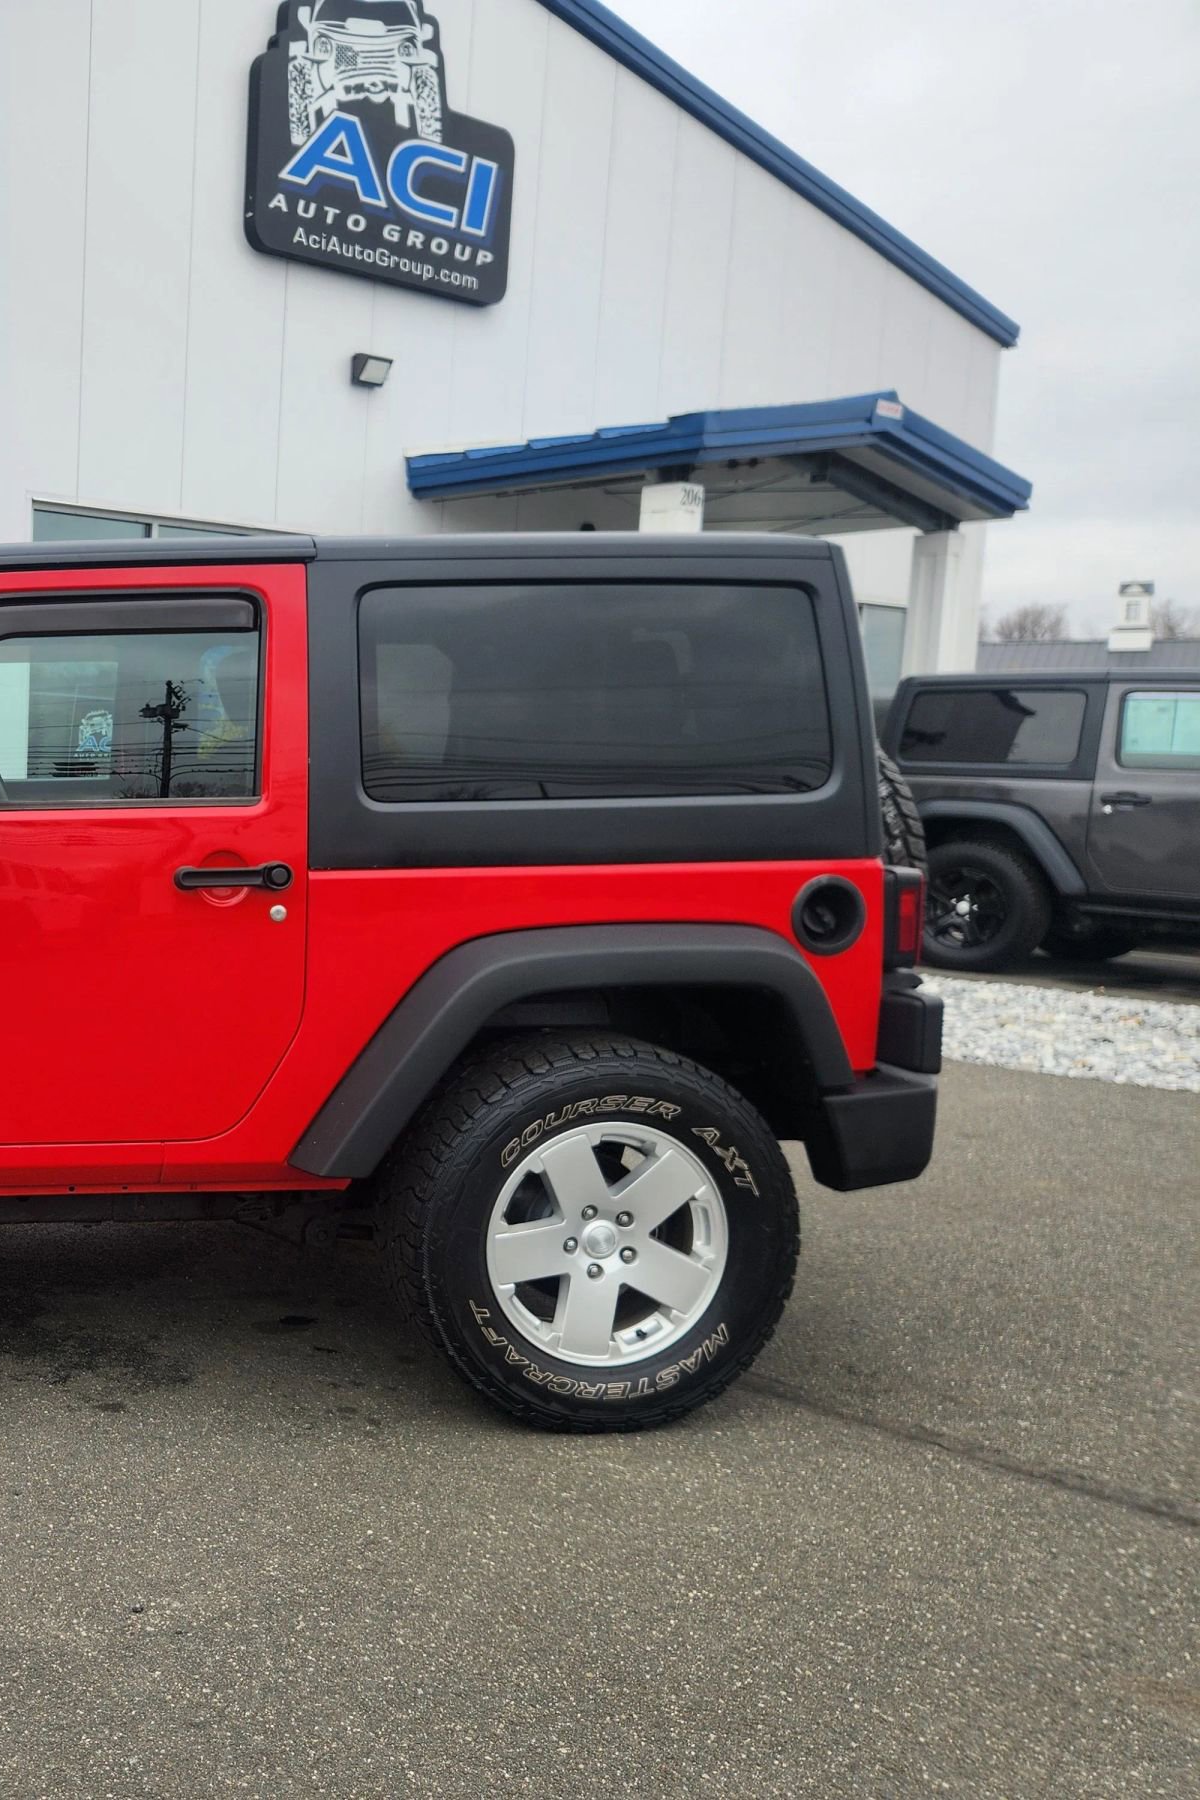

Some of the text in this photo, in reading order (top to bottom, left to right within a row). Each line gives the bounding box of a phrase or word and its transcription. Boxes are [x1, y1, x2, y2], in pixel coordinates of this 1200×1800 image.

[278, 110, 498, 237] ACI
[268, 192, 494, 266] AUTO GROUP
[292, 226, 480, 290] AciAutoGroup.com
[501, 1095, 761, 1198] COURSER AXT
[470, 1300, 729, 1400] MASTERCRAFT
